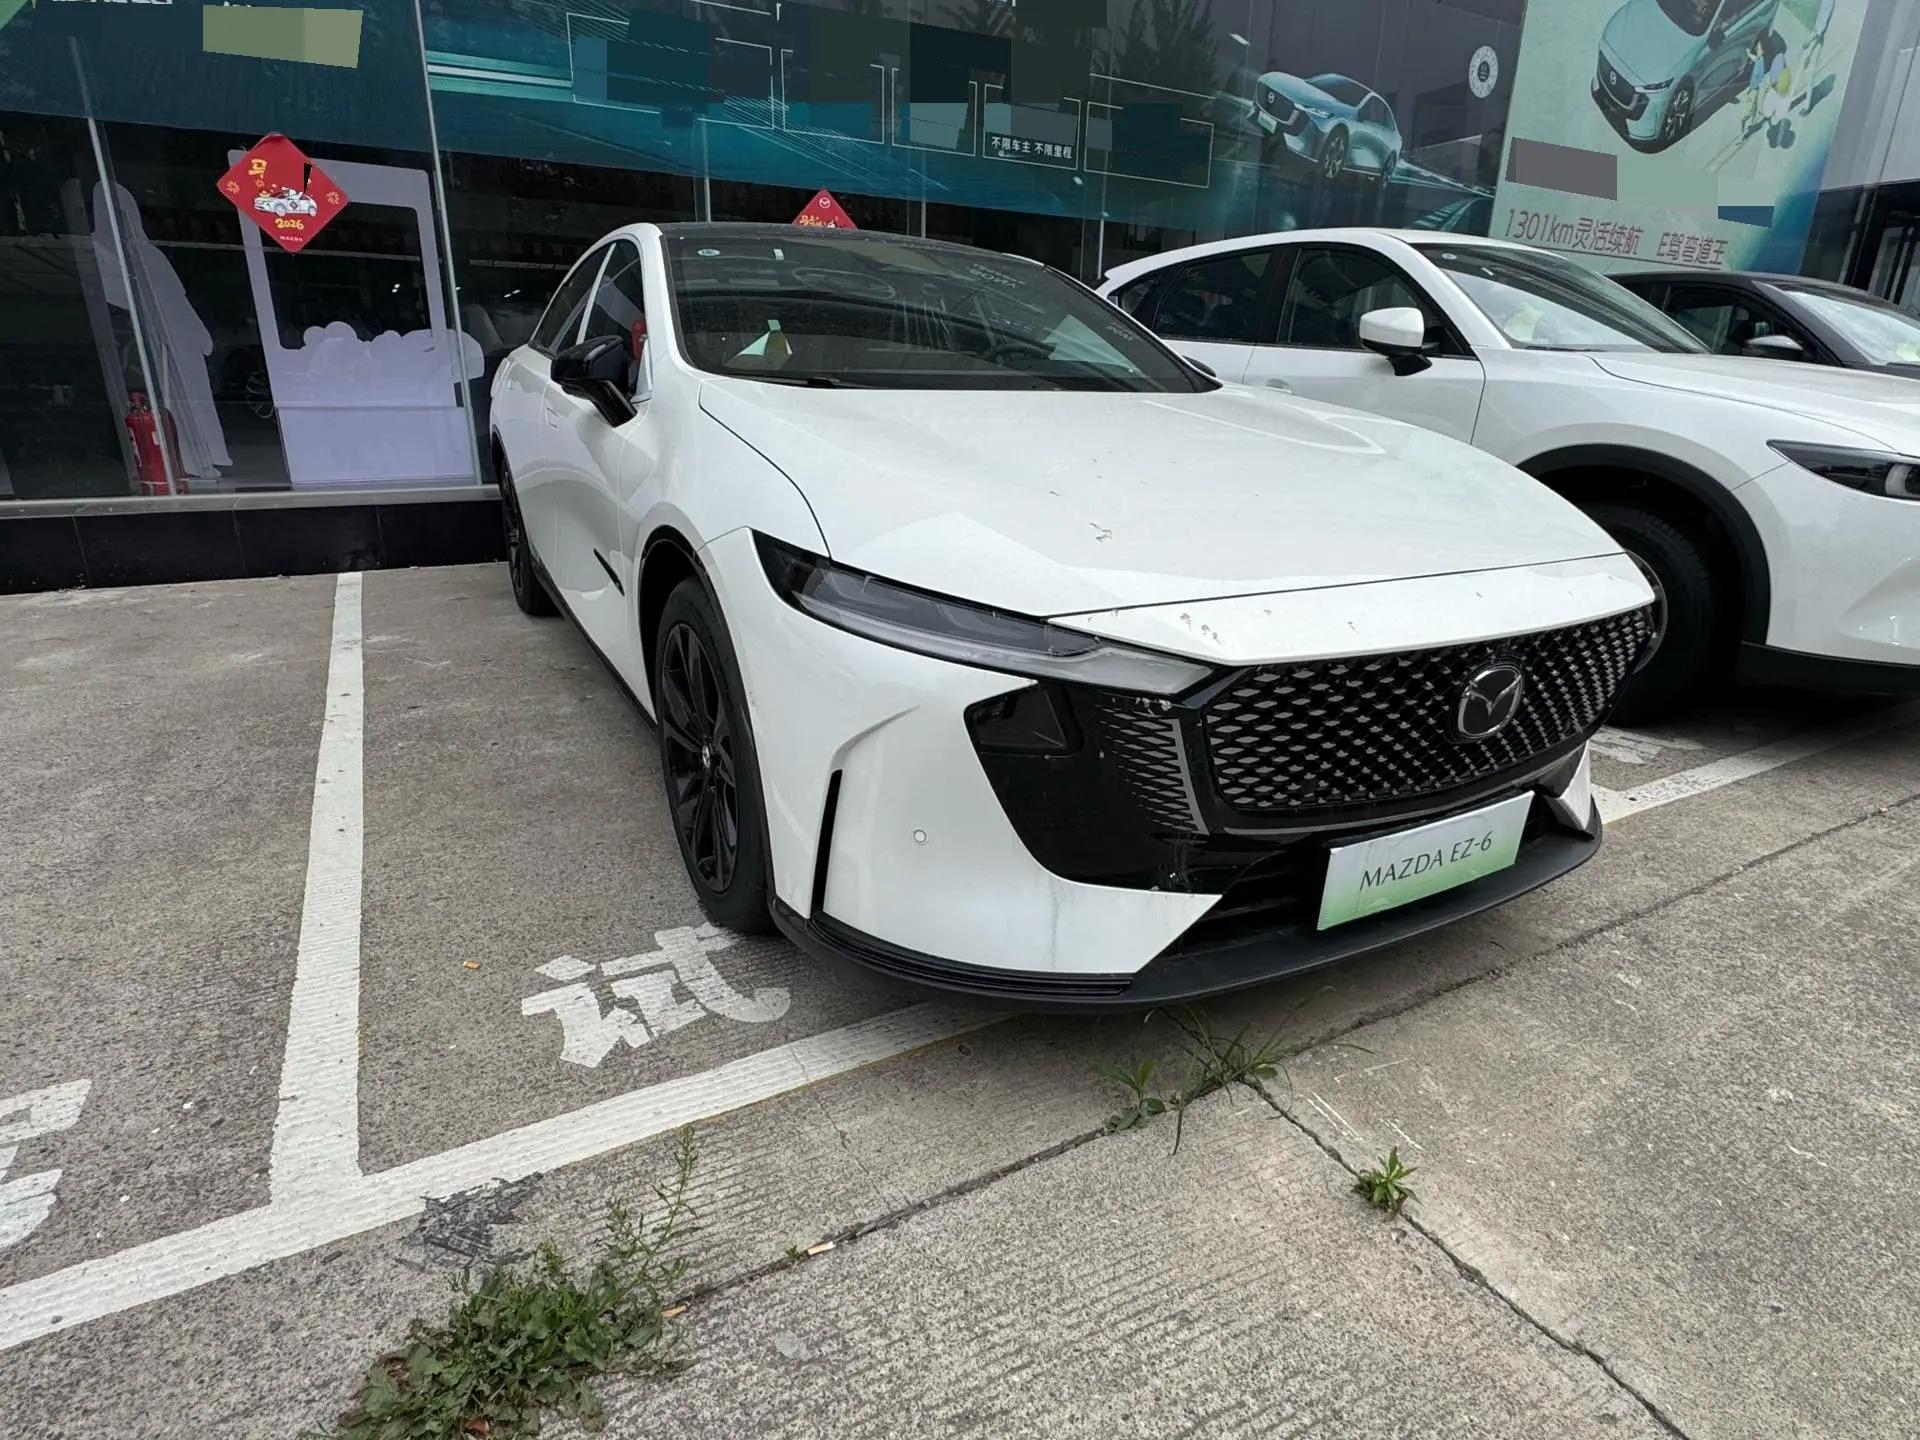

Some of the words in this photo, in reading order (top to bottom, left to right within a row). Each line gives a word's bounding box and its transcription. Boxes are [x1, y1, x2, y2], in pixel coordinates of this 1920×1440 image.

[992, 136, 1031, 153] 不限车主
[1034, 142, 1073, 159] 不限里程
[275, 218, 304, 230] 2026
[1656, 231, 1729, 266] E驾弯道王
[1360, 849, 1444, 891] MAZDA
[1450, 830, 1493, 863] EZ-6
[521, 922, 791, 1068] 试
